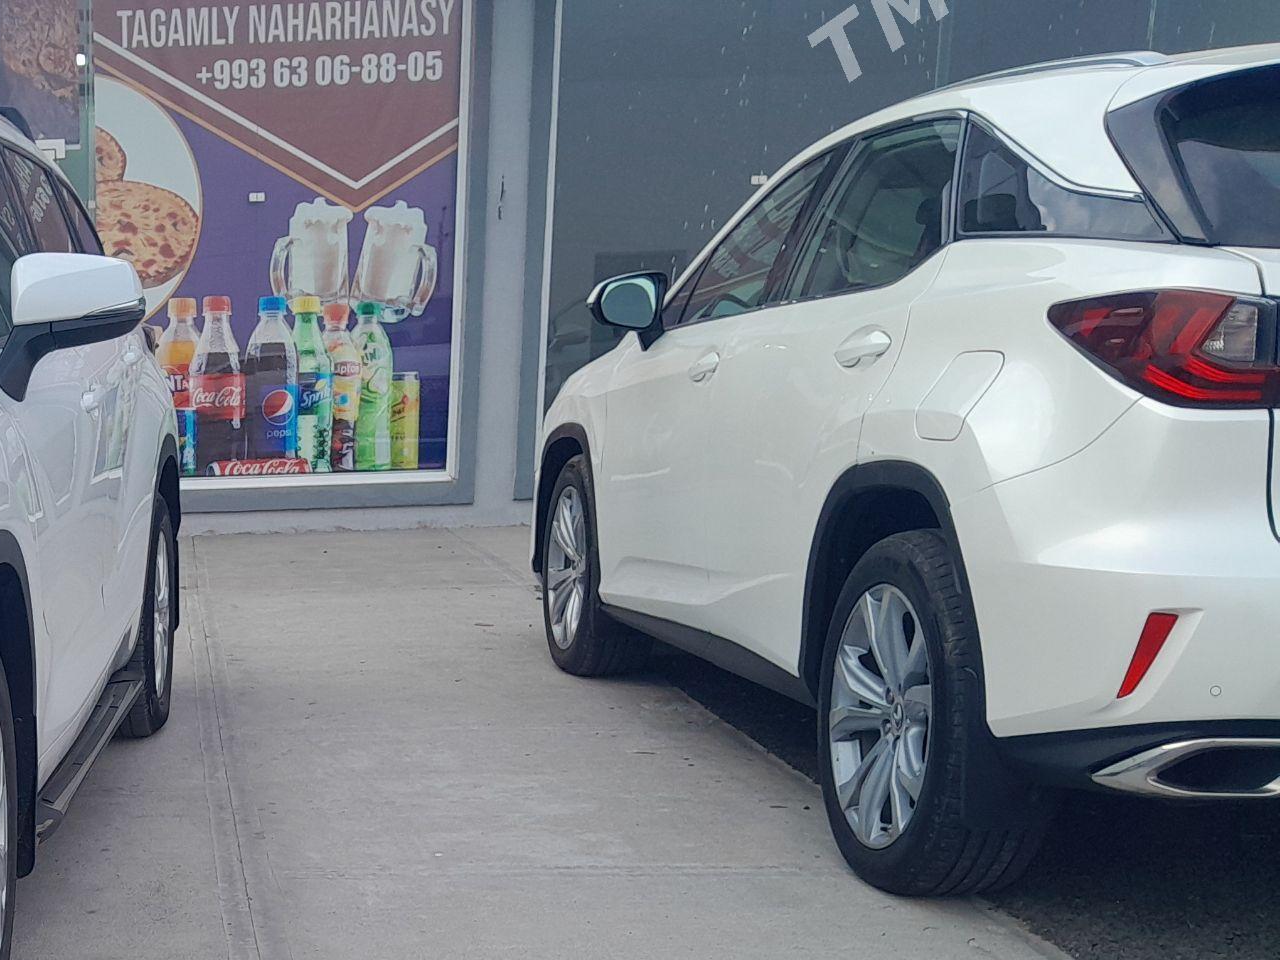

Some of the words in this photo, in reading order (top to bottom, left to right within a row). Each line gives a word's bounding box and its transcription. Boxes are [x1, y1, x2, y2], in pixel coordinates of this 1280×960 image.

[117, 6, 240, 49] TAGAMLY
[248, 0, 455, 44] NAHARHANASY
[196, 58, 266, 90] +993
[273, 56, 308, 88] 63
[315, 51, 443, 86] 06-88-05
